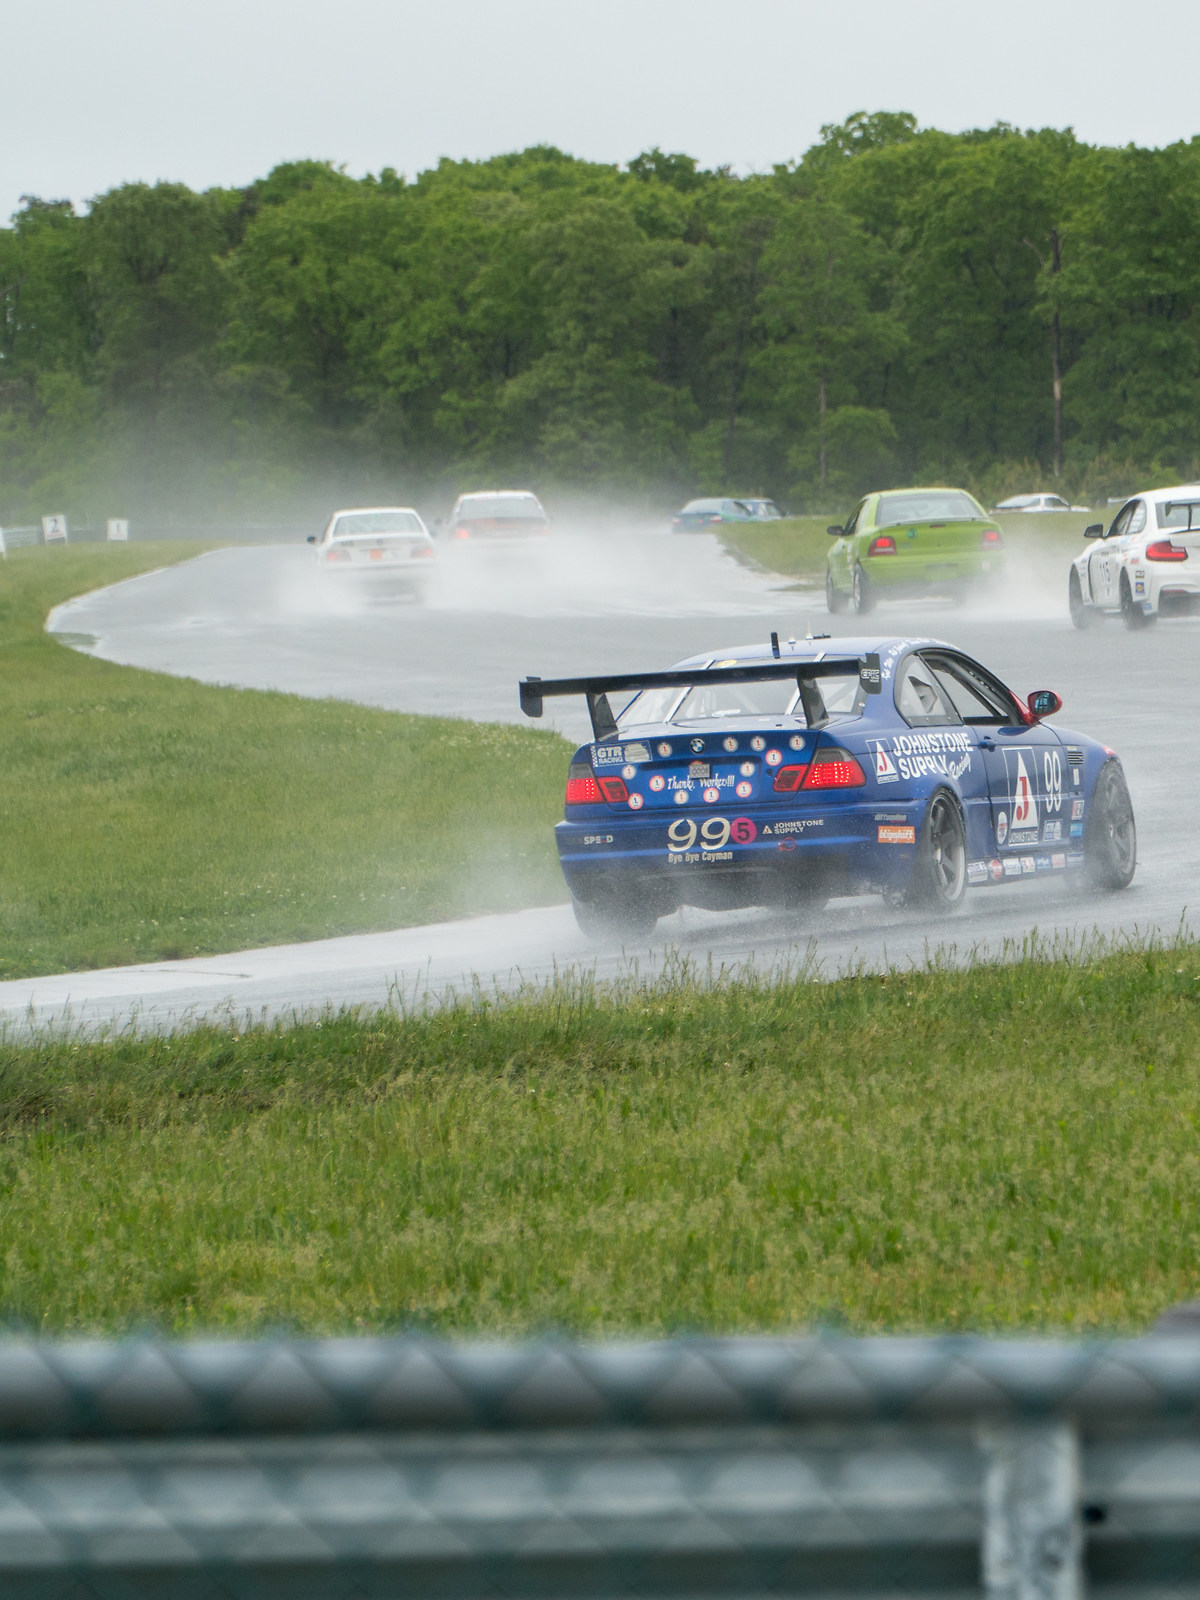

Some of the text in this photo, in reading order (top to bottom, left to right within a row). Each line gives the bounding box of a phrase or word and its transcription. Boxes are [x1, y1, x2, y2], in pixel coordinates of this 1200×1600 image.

[597, 746, 622, 758] GTR
[892, 732, 974, 757] JOHNSTONE
[598, 756, 623, 764] RACING
[898, 754, 949, 780] SUPPLY
[1044, 750, 1062, 813] 99
[736, 822, 749, 841] 5
[774, 819, 824, 829] JOHNSTONE
[774, 827, 804, 835] SUPPLY
[667, 817, 731, 852] 99
[668, 851, 733, 864] Bye Bye Cayman
